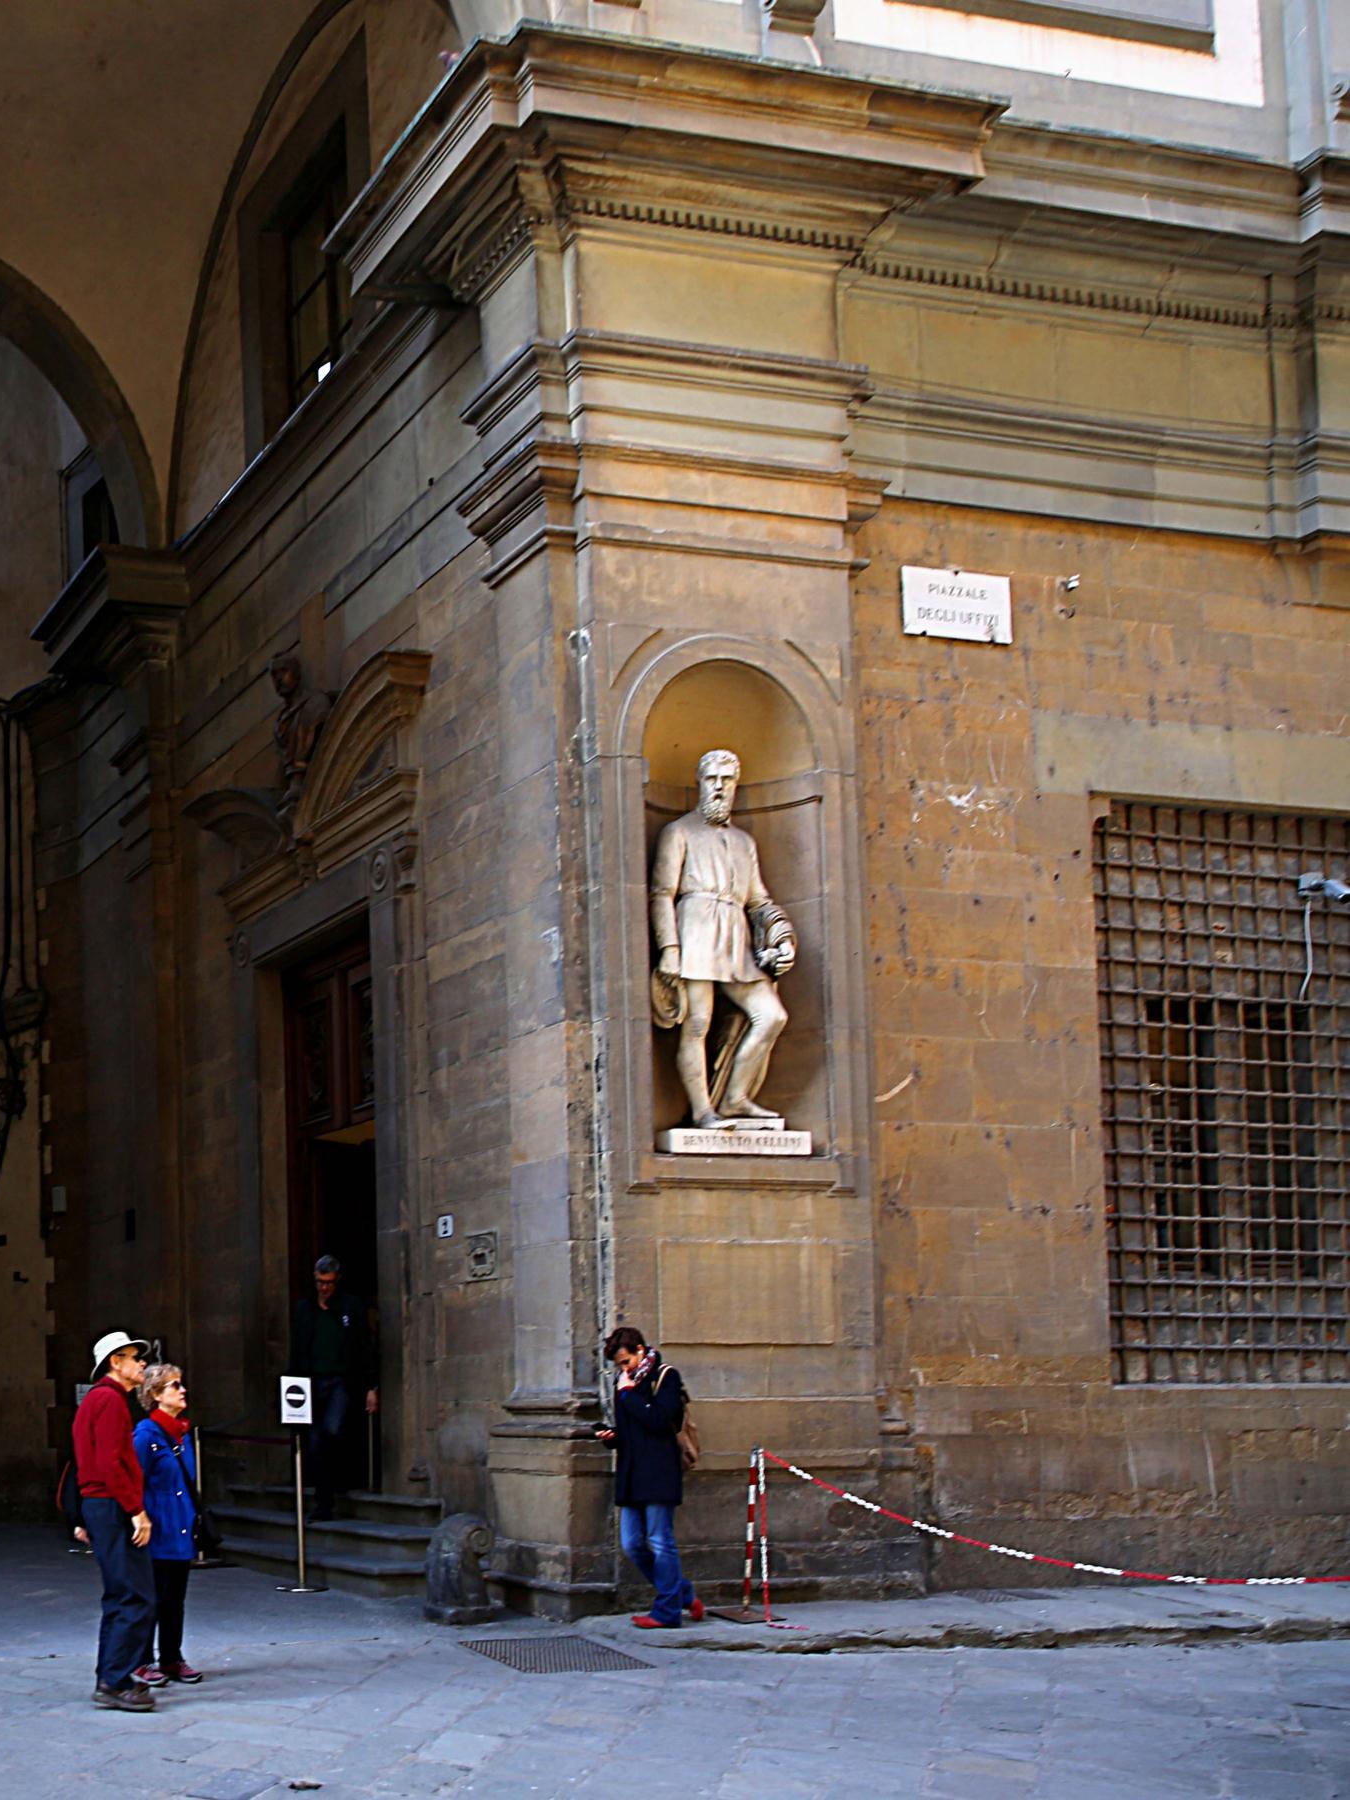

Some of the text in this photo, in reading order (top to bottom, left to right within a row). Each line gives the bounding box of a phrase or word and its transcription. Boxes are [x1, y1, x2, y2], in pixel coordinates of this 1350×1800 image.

[928, 583, 988, 600] PIAZZALE
[917, 607, 999, 627] DEGLI UFFIZI
